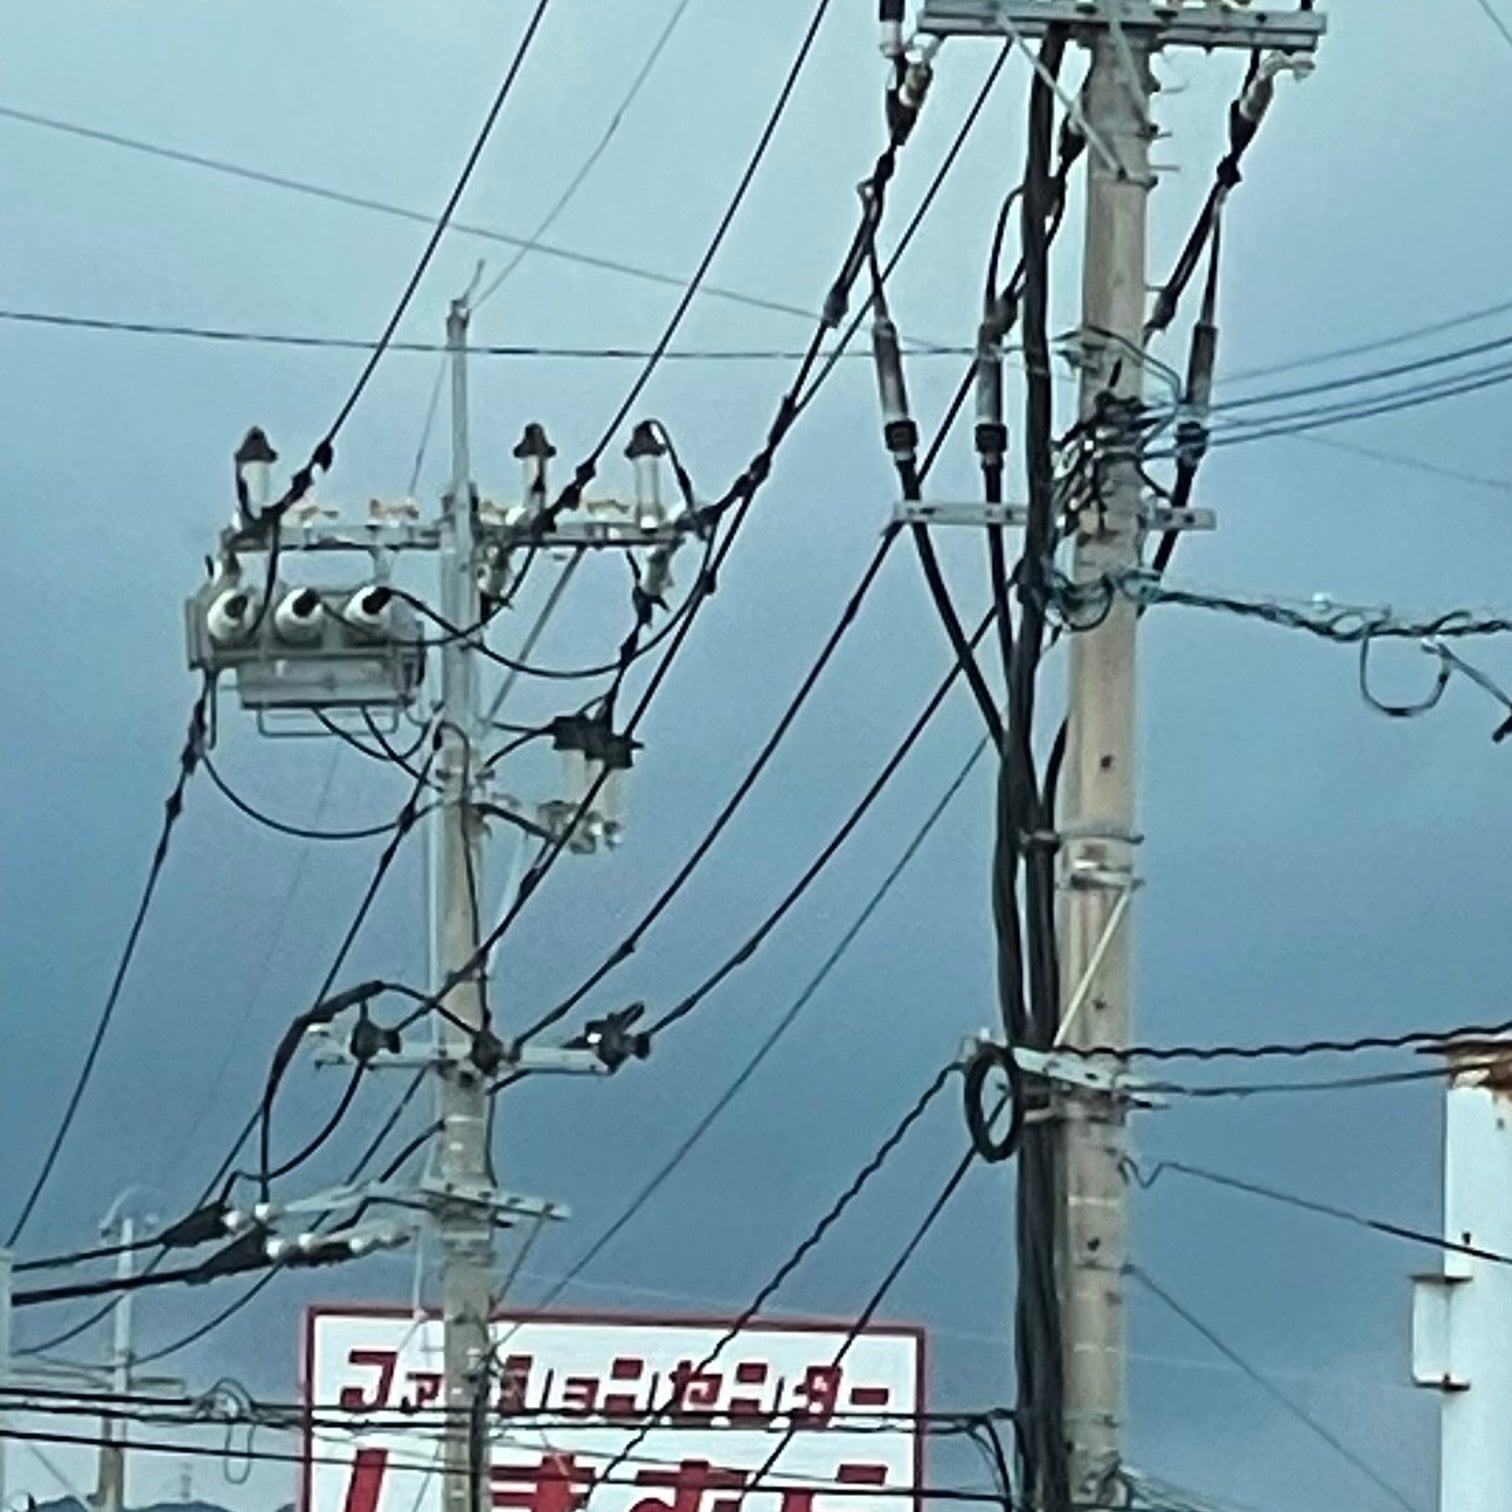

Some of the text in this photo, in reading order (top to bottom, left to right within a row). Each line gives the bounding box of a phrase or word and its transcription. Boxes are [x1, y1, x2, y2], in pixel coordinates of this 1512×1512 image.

[338, 1350, 890, 1427] ファションセンター
